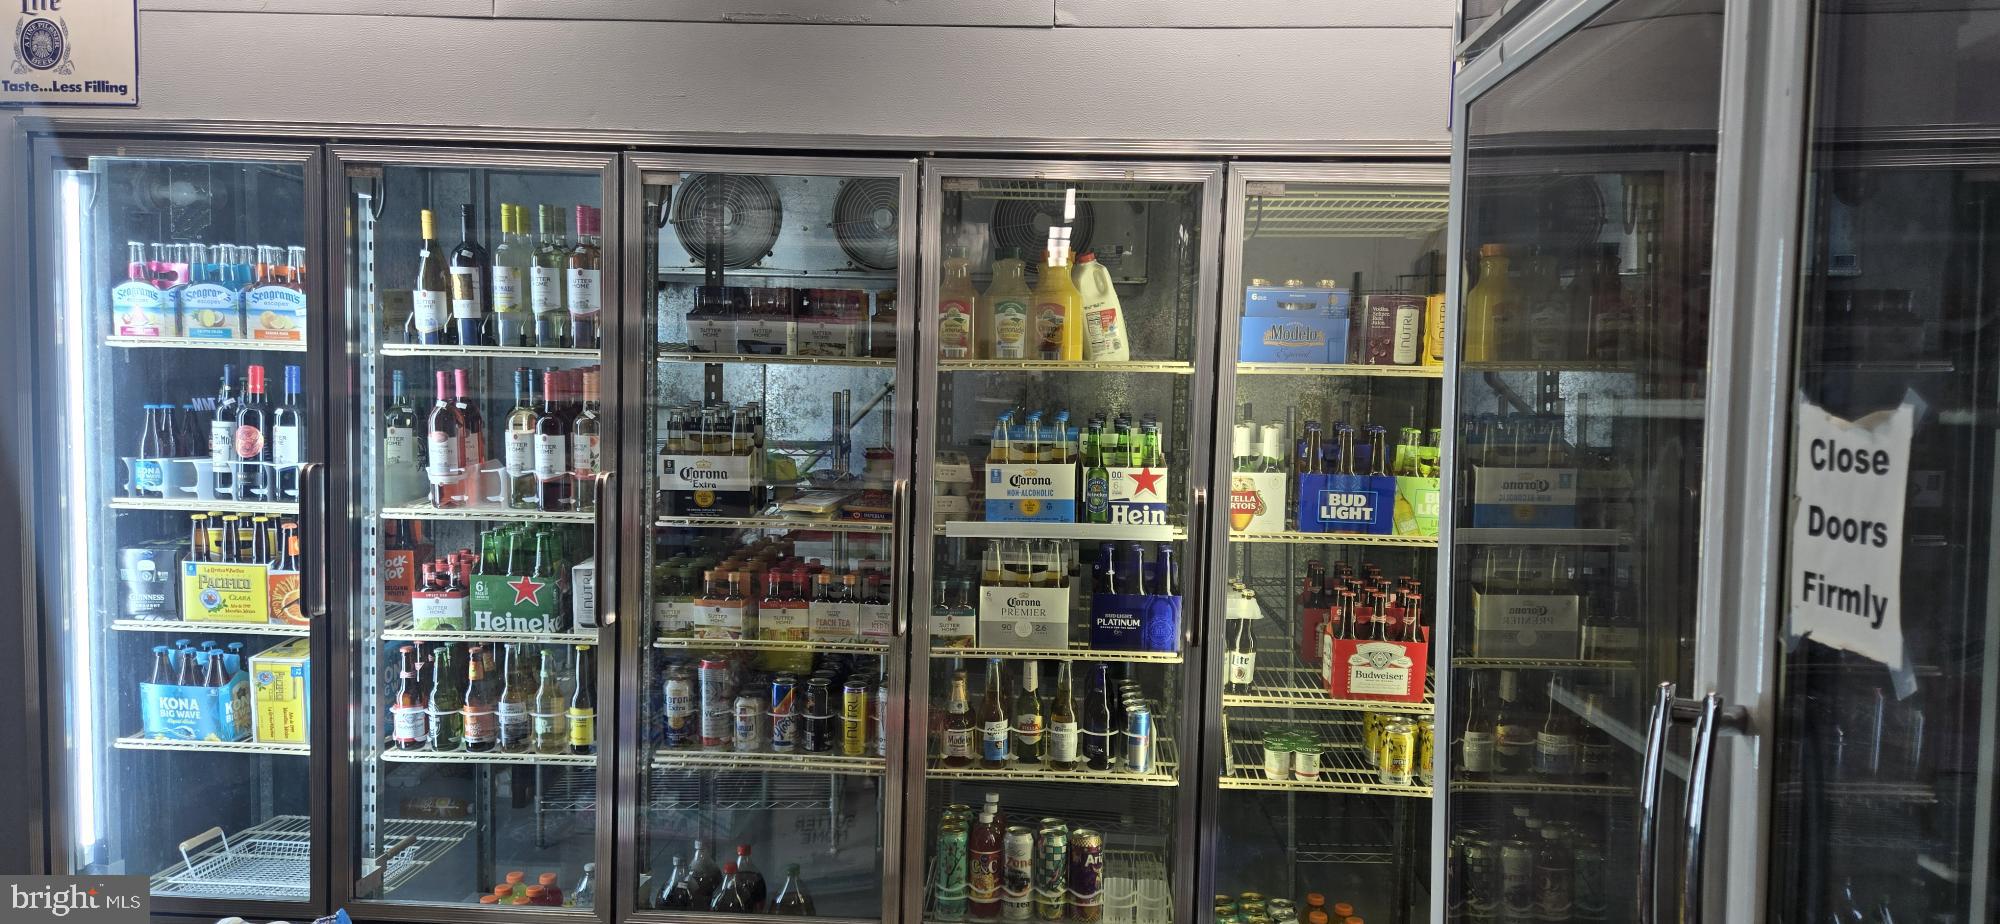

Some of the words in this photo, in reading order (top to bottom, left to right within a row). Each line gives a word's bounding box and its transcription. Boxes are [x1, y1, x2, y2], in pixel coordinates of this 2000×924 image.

[84, 80, 128, 95] Filling
[252, 289, 301, 305] Seagram's
[1251, 293, 1258, 301] 6
[1271, 324, 1317, 341] Modelo
[1369, 356, 1376, 365] 4
[1810, 438, 1890, 476] Close
[680, 466, 729, 483] Corona
[1009, 474, 1052, 488] Corona
[692, 480, 717, 489] Extra
[1007, 489, 1054, 497] NON-ALCOHOLIC
[1328, 493, 1368, 507] BUD
[1321, 506, 1374, 521] LIGHT
[1808, 505, 1889, 549] Doors
[199, 574, 252, 589] PACIFICO
[476, 580, 484, 592] 6
[1007, 597, 1041, 608] Corona
[1803, 571, 1889, 630] Firmly
[1001, 608, 1047, 617] PREMIER
[1097, 618, 1141, 627] PLATINUM
[1355, 670, 1404, 681] Budweiser
[160, 696, 199, 711] KONA
[160, 709, 175, 718] BIG
[176, 710, 201, 720] WAVE
